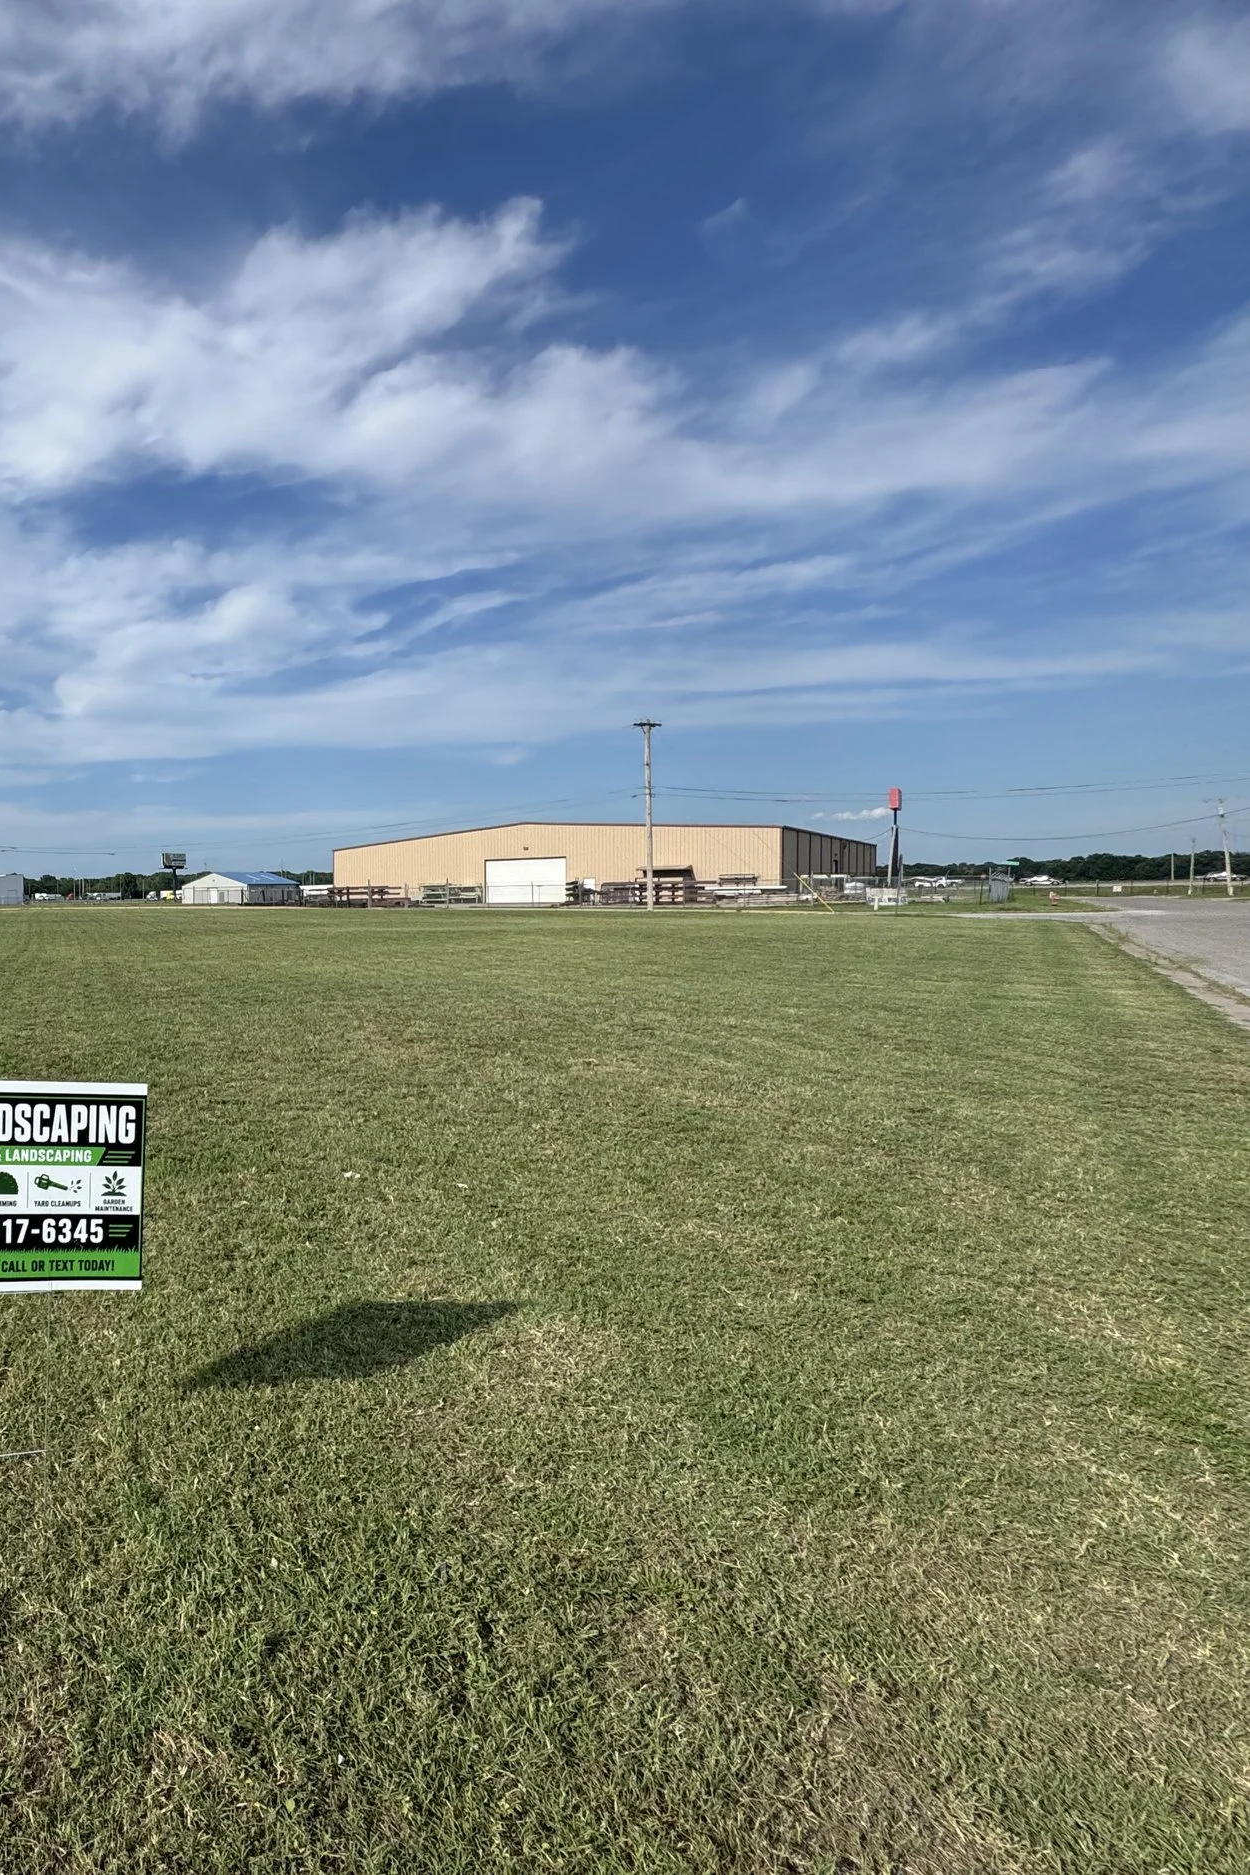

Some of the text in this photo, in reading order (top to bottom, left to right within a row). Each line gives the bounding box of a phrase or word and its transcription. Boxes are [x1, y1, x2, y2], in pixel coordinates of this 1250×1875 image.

[5, 1149, 92, 1163] LANDSCAPING
[1, 1260, 27, 1273] CALL
[31, 1260, 45, 1272] OR
[49, 1260, 75, 1272] TEXT
[78, 1259, 115, 1272] TODAY!
